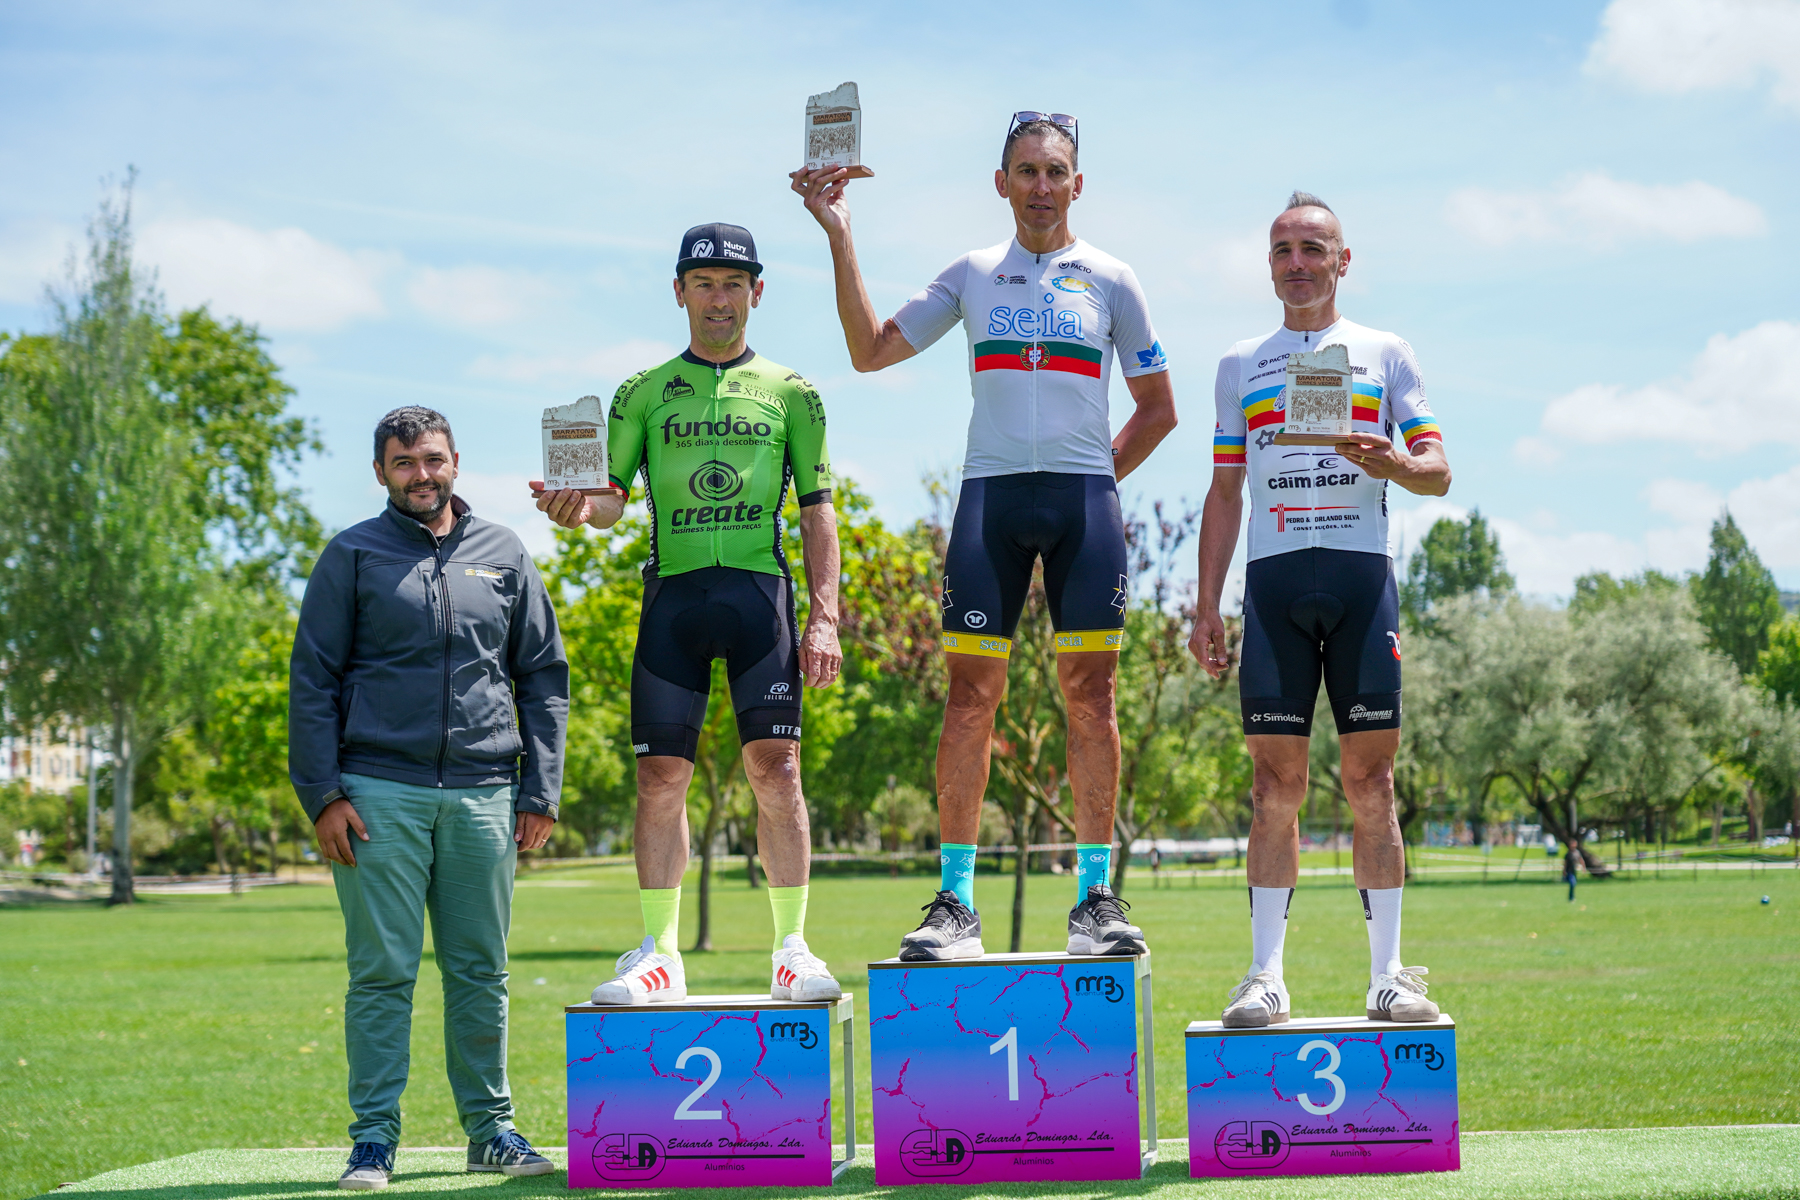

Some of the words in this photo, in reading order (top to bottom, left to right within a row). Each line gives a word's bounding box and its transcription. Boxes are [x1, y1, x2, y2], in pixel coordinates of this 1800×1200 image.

[813, 112, 851, 120] MARATONA
[723, 240, 747, 254] Nutry
[723, 249, 749, 261] Fitness
[1070, 262, 1092, 274] PACTO
[988, 292, 1085, 340] seia
[1269, 353, 1290, 364] PACTO
[621, 382, 640, 408] GROUPE
[743, 387, 784, 409] XISTO
[796, 384, 814, 412] GROUPE
[660, 413, 771, 444] fundão
[675, 439, 692, 449] 365
[695, 438, 714, 447] dias
[722, 438, 771, 448] descoberta
[1268, 473, 1359, 490] caimacar
[671, 501, 763, 527] create
[671, 526, 704, 534] business
[943, 631, 958, 647] eia
[979, 636, 1008, 652] seia
[1057, 631, 1083, 647] seia
[1263, 712, 1305, 723] Simoldes
[1349, 709, 1394, 719] PADEIRINHAS
[772, 724, 793, 734] BTT
[989, 1026, 1019, 1101] 1
[673, 1046, 722, 1120] 2
[1296, 1039, 1346, 1115] 3
[1291, 1123, 1338, 1136] Eduardo
[1404, 1121, 1432, 1132] Lda.
[667, 1138, 713, 1149] Eduardo
[777, 1137, 804, 1147] Lda.
[975, 1133, 1022, 1144] Eduardo
[1086, 1130, 1114, 1141] Lda.
[1330, 1149, 1371, 1158] Alumínios
[704, 1163, 745, 1171] Alumínios
[1013, 1157, 1054, 1166] Alumínios
